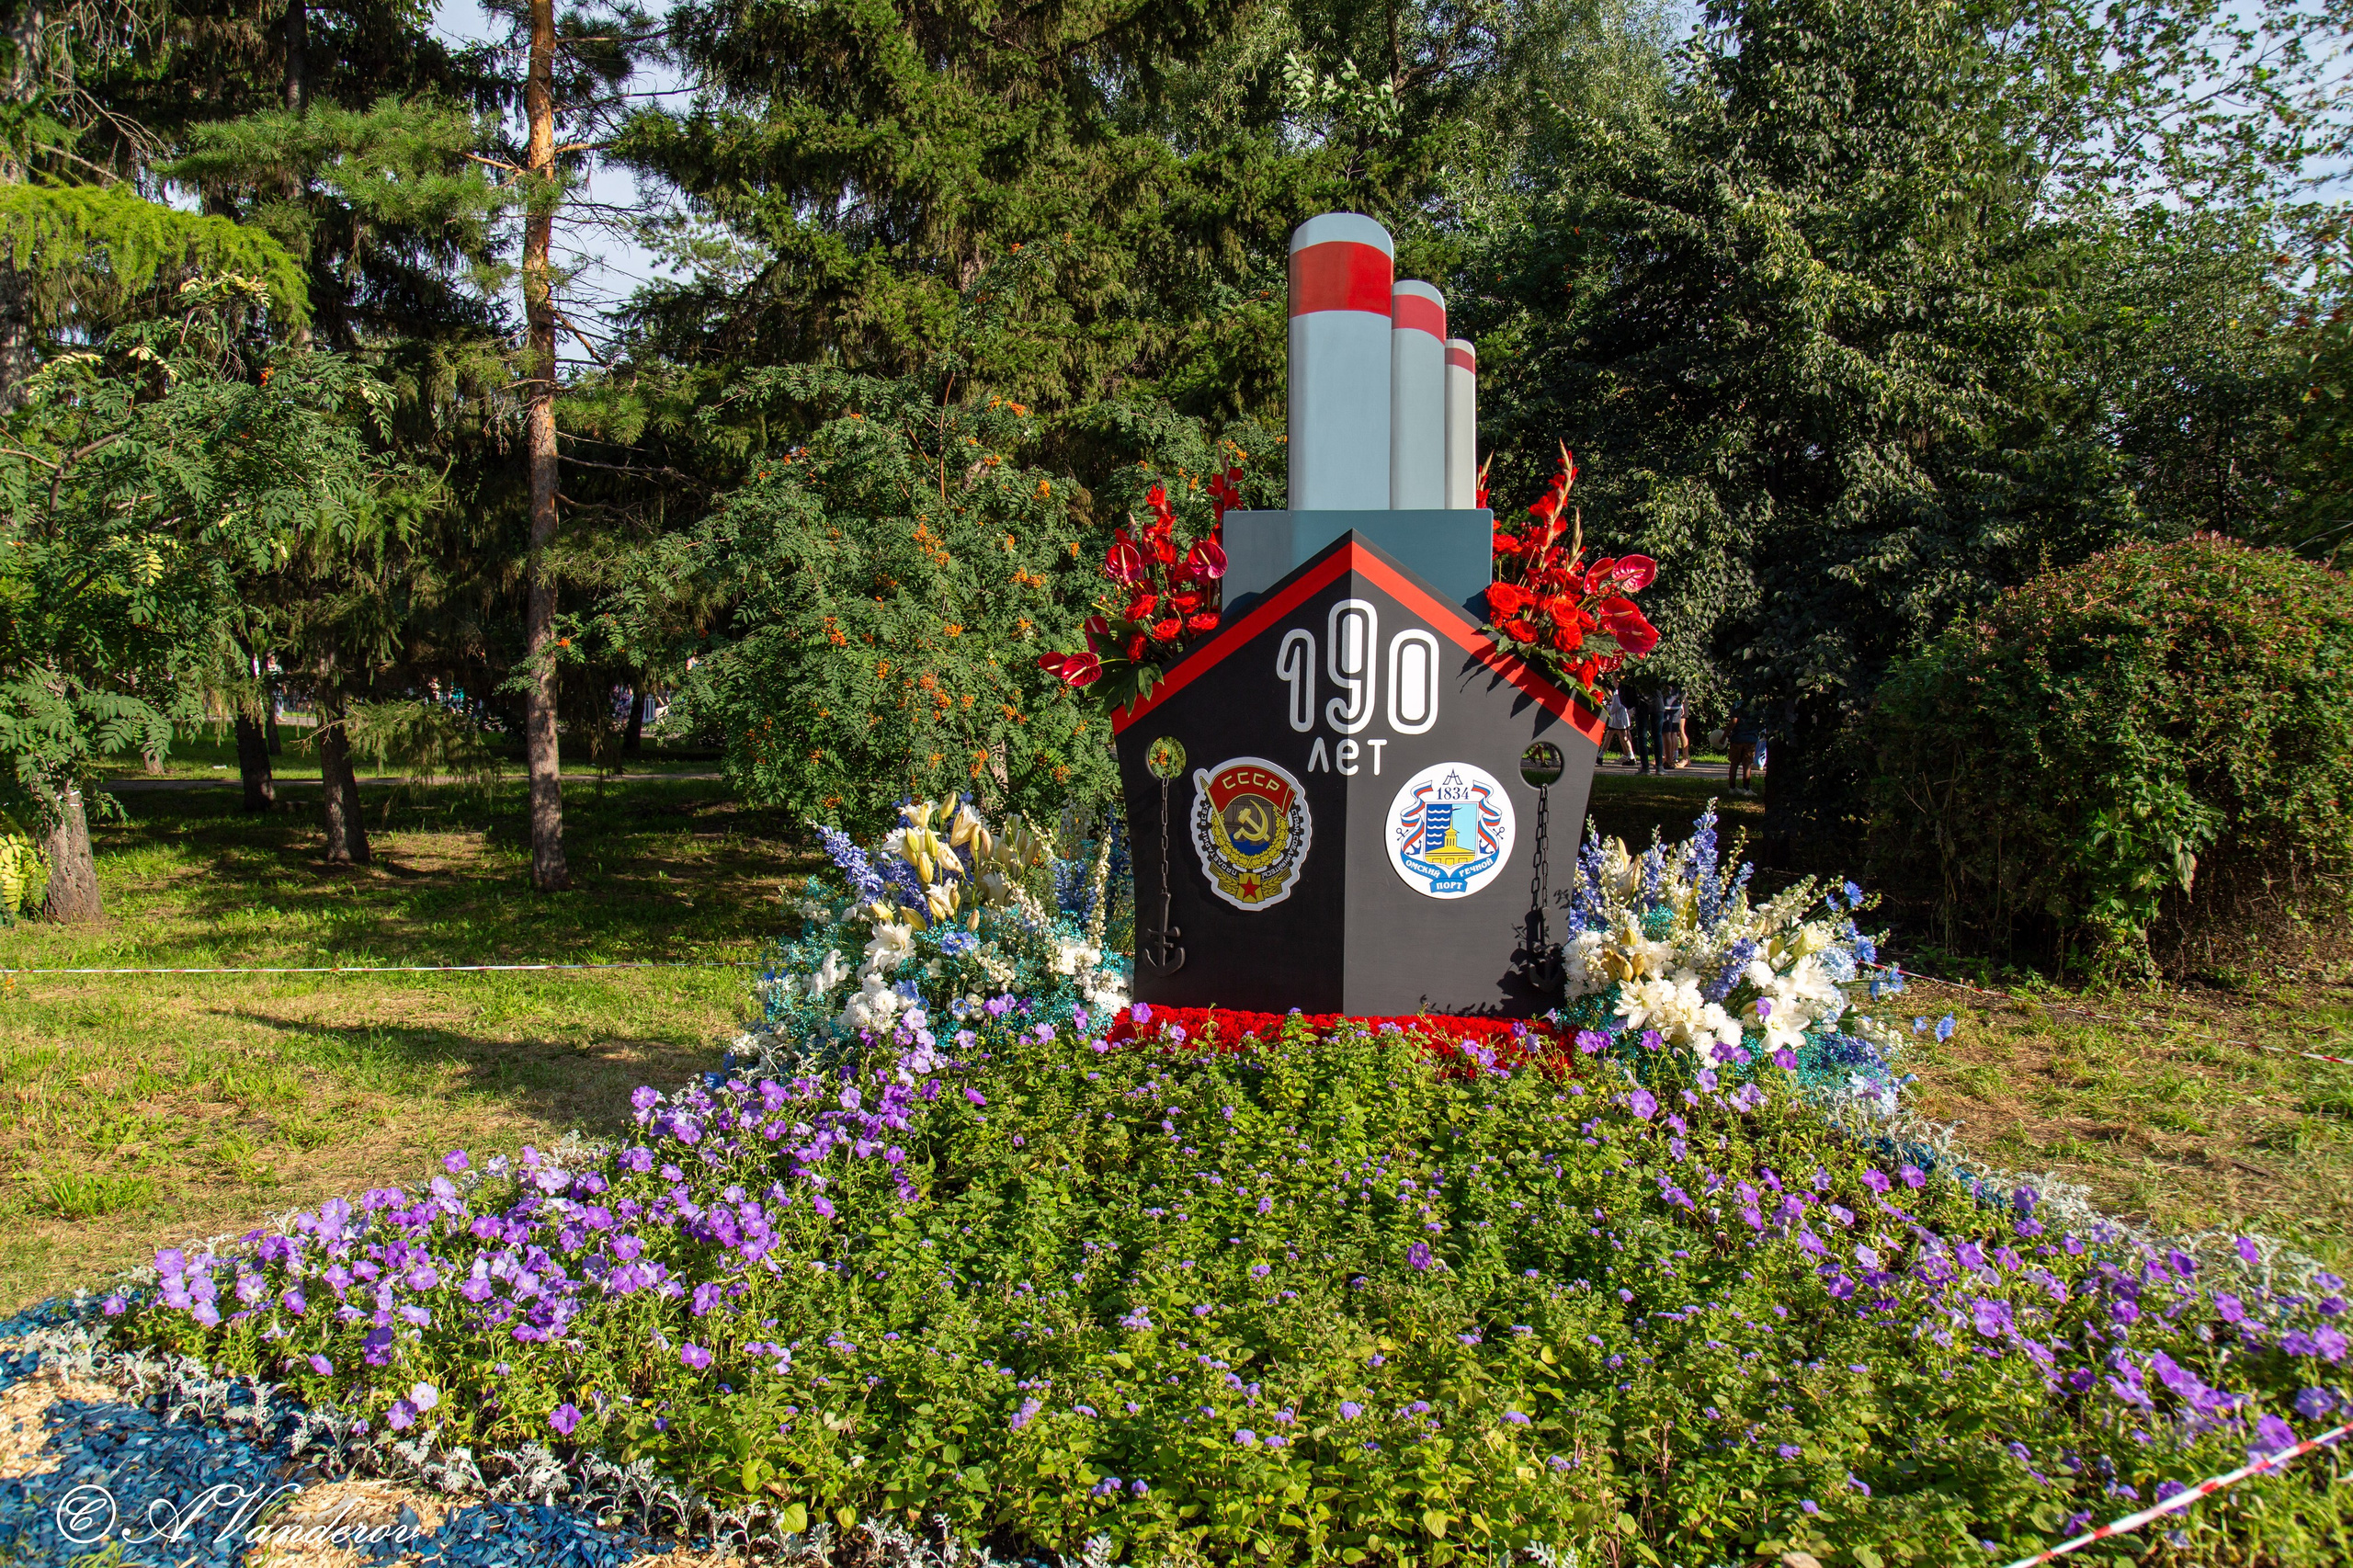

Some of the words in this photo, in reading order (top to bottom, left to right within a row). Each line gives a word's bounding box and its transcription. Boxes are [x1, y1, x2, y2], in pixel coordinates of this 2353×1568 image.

[1276, 598, 1440, 735] 190
[1222, 771, 1280, 791] СССР
[1437, 786, 1470, 801] 1834
[1200, 802, 1210, 826] ВСЕХ
[1405, 858, 1441, 879] ОМСКИЙ
[1458, 857, 1494, 878] РЕЧНОЙ
[1436, 881, 1463, 891] ПОРТ
